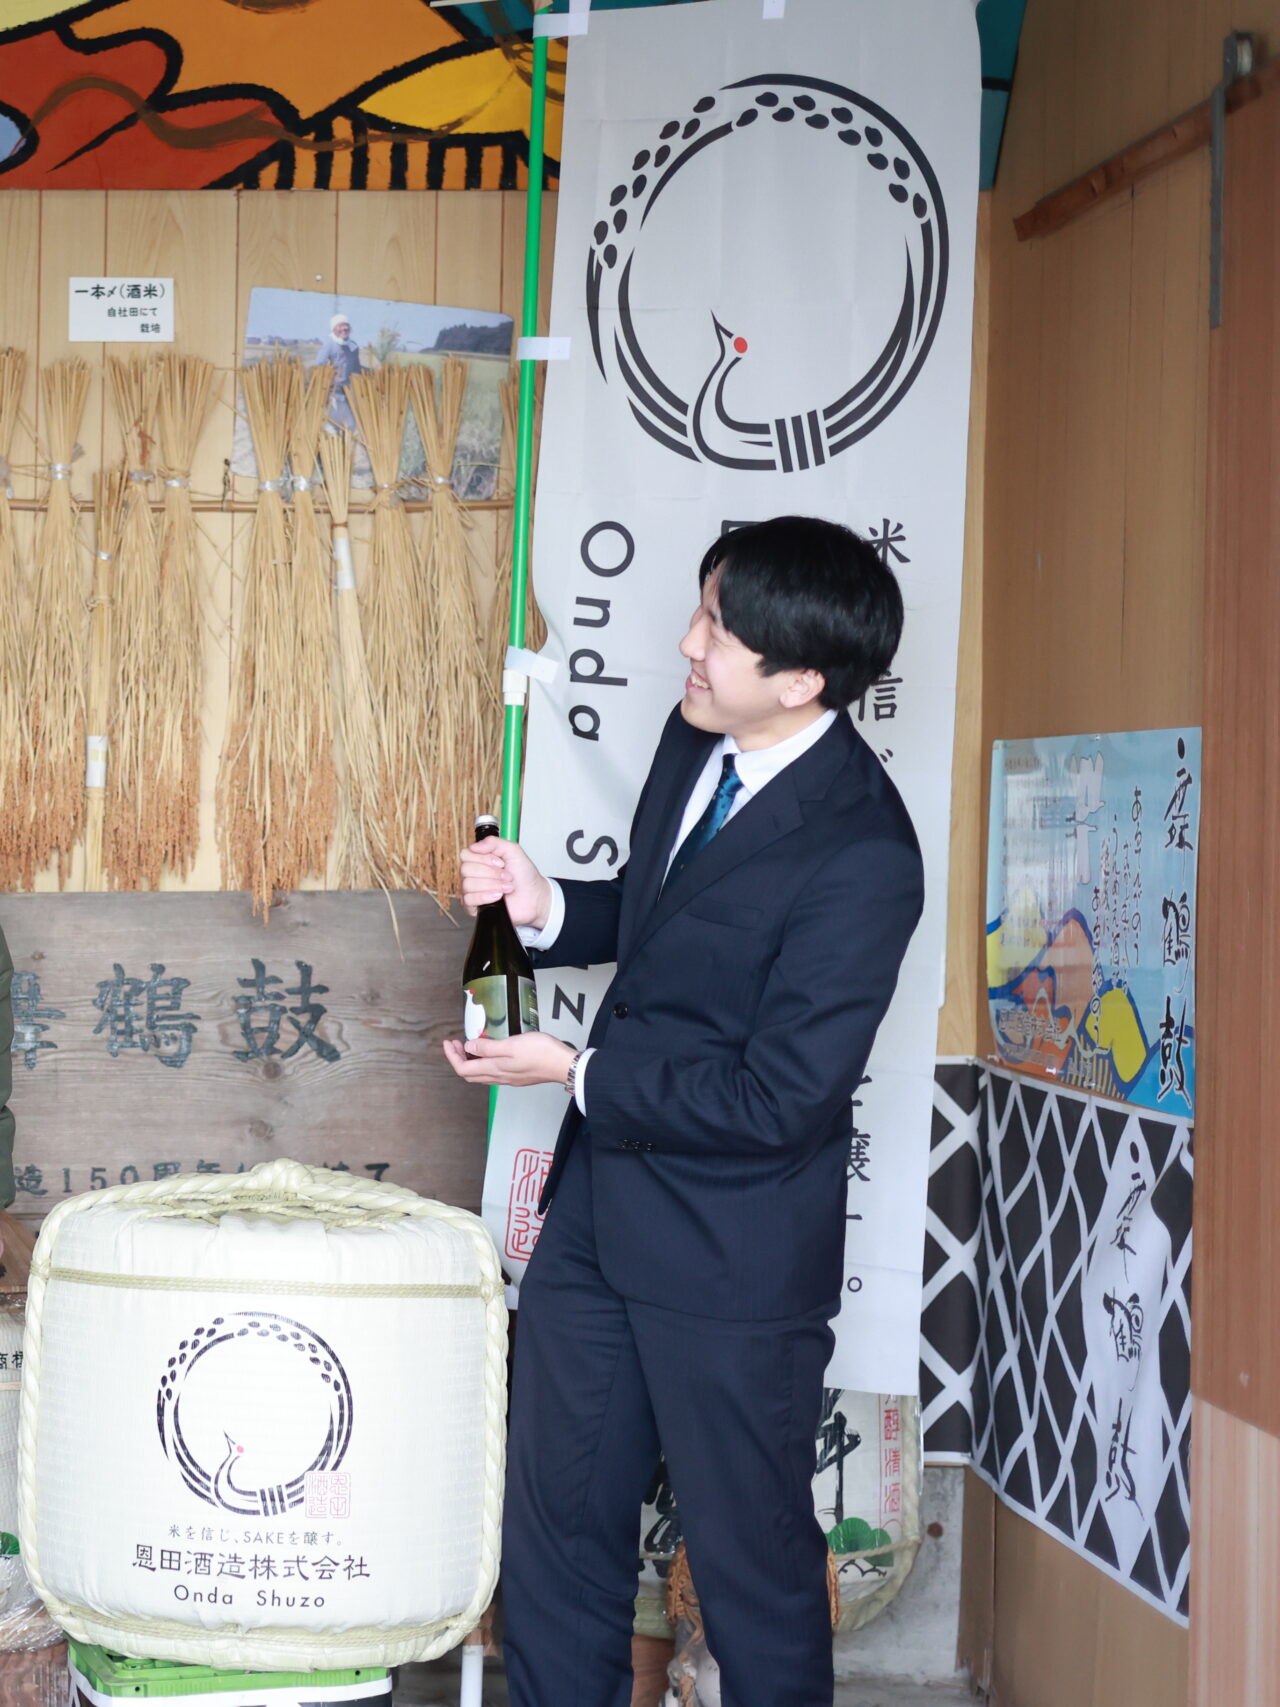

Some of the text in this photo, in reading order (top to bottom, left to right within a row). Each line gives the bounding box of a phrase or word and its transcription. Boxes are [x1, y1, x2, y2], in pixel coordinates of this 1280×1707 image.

[107, 306, 158, 317] 自社田にて
[140, 323, 160, 333] 栽培
[568, 520, 635, 741] Onda
[169, 1524, 342, 1546] 米を信じ、SAKEを醸す。
[132, 1544, 370, 1581] 恩田酒造株式会社
[174, 1584, 325, 1608] Onda Shuzo
